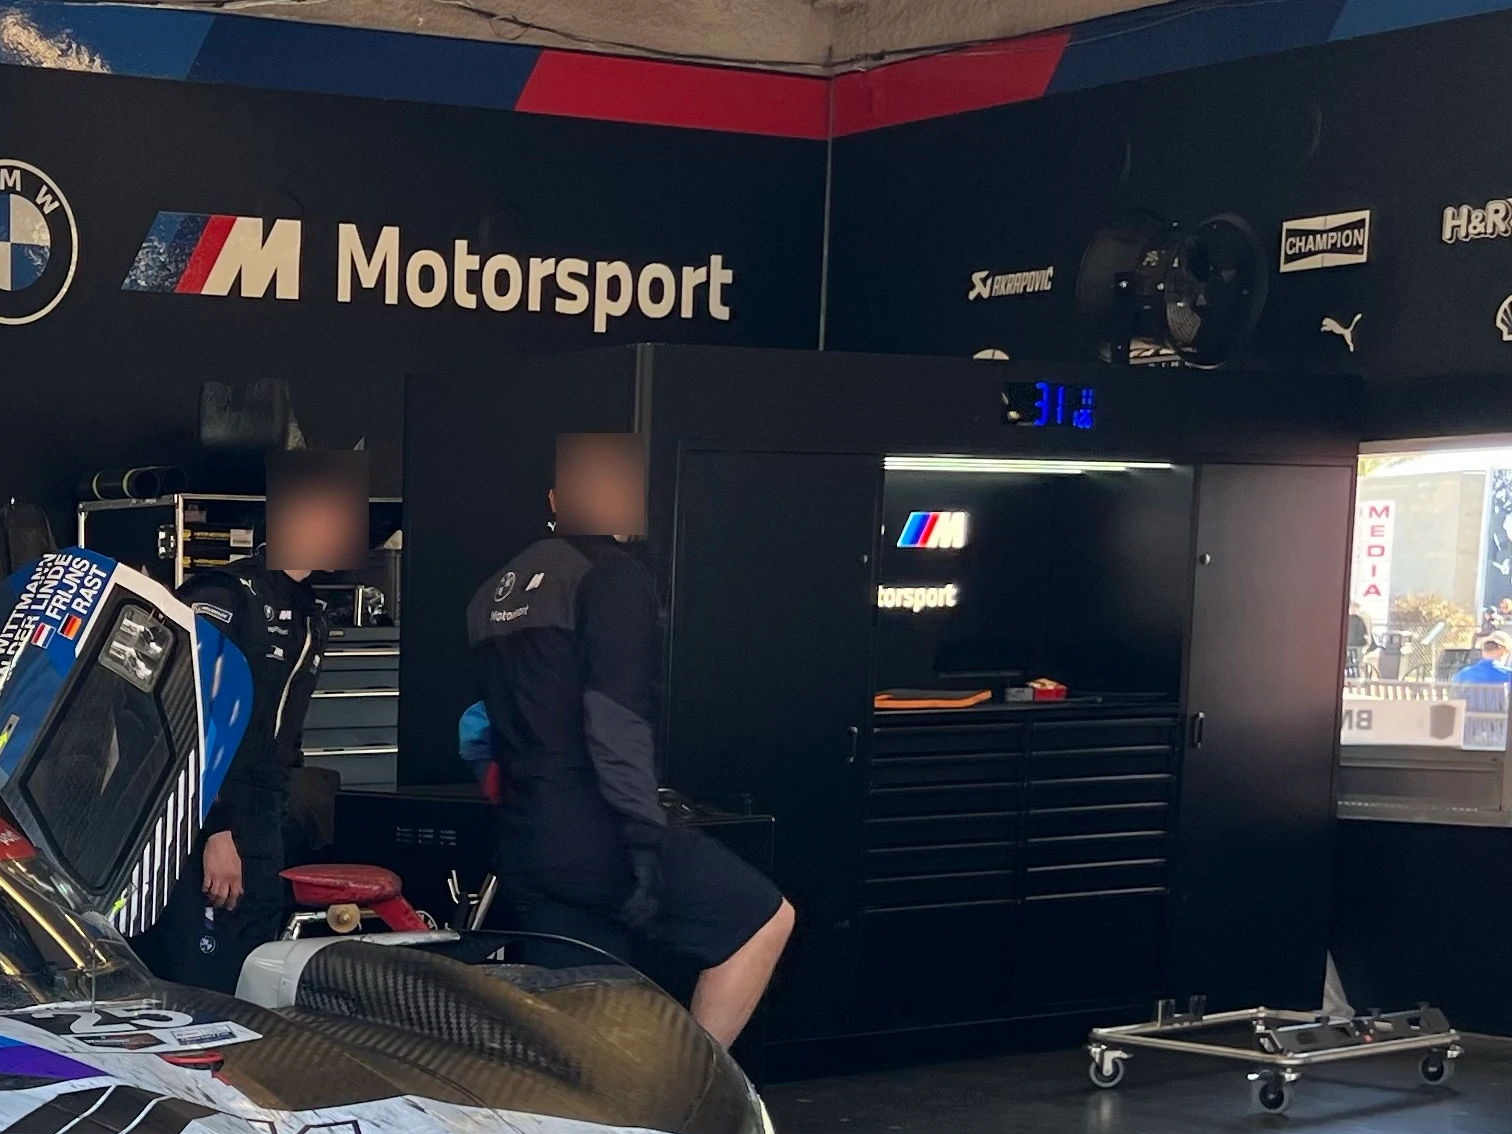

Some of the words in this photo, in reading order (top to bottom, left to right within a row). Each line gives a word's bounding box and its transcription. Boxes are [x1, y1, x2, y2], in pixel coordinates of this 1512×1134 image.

[1286, 228, 1365, 255] CHAMPION
[1443, 201, 1512, 244] H&R
[336, 222, 734, 333] Motorsport
[1362, 505, 1390, 597] MEDIA
[31, 553, 73, 610] LINDE
[45, 557, 90, 621] FRIJNS
[71, 562, 108, 615] RAST
[31, 1006, 194, 1034] 25
